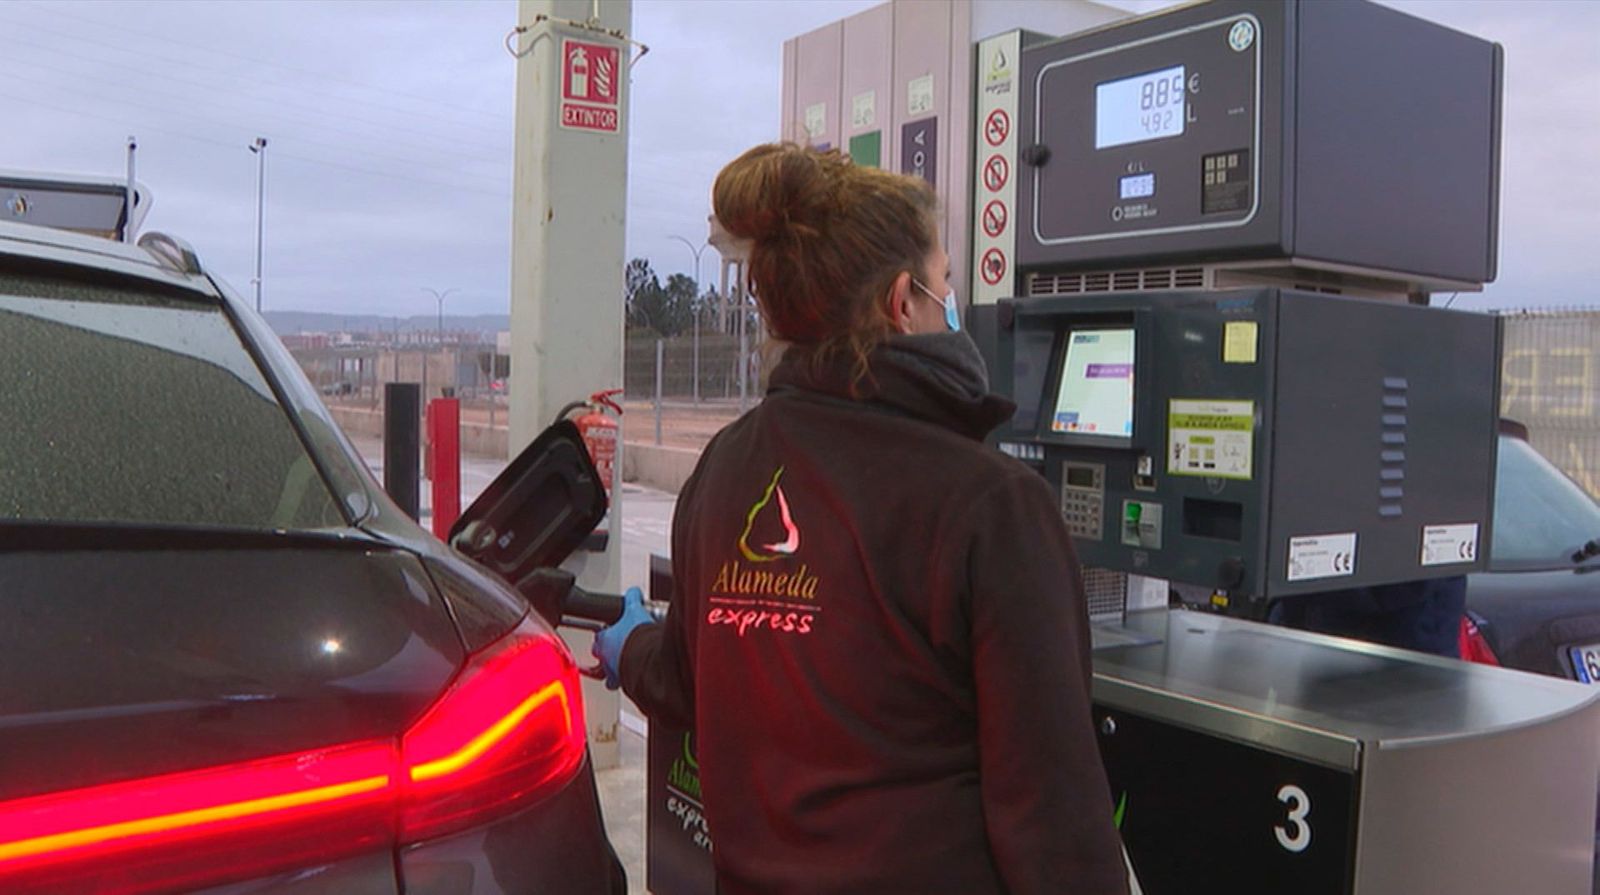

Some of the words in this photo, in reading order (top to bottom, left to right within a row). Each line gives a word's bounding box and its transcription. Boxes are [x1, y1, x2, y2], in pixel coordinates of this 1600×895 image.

[564, 107, 616, 128] EXTINTOR
[1187, 104, 1197, 122] L
[913, 130, 925, 146] A
[712, 561, 818, 599] Alameda
[708, 607, 814, 637] express
[1274, 784, 1311, 852] 3
